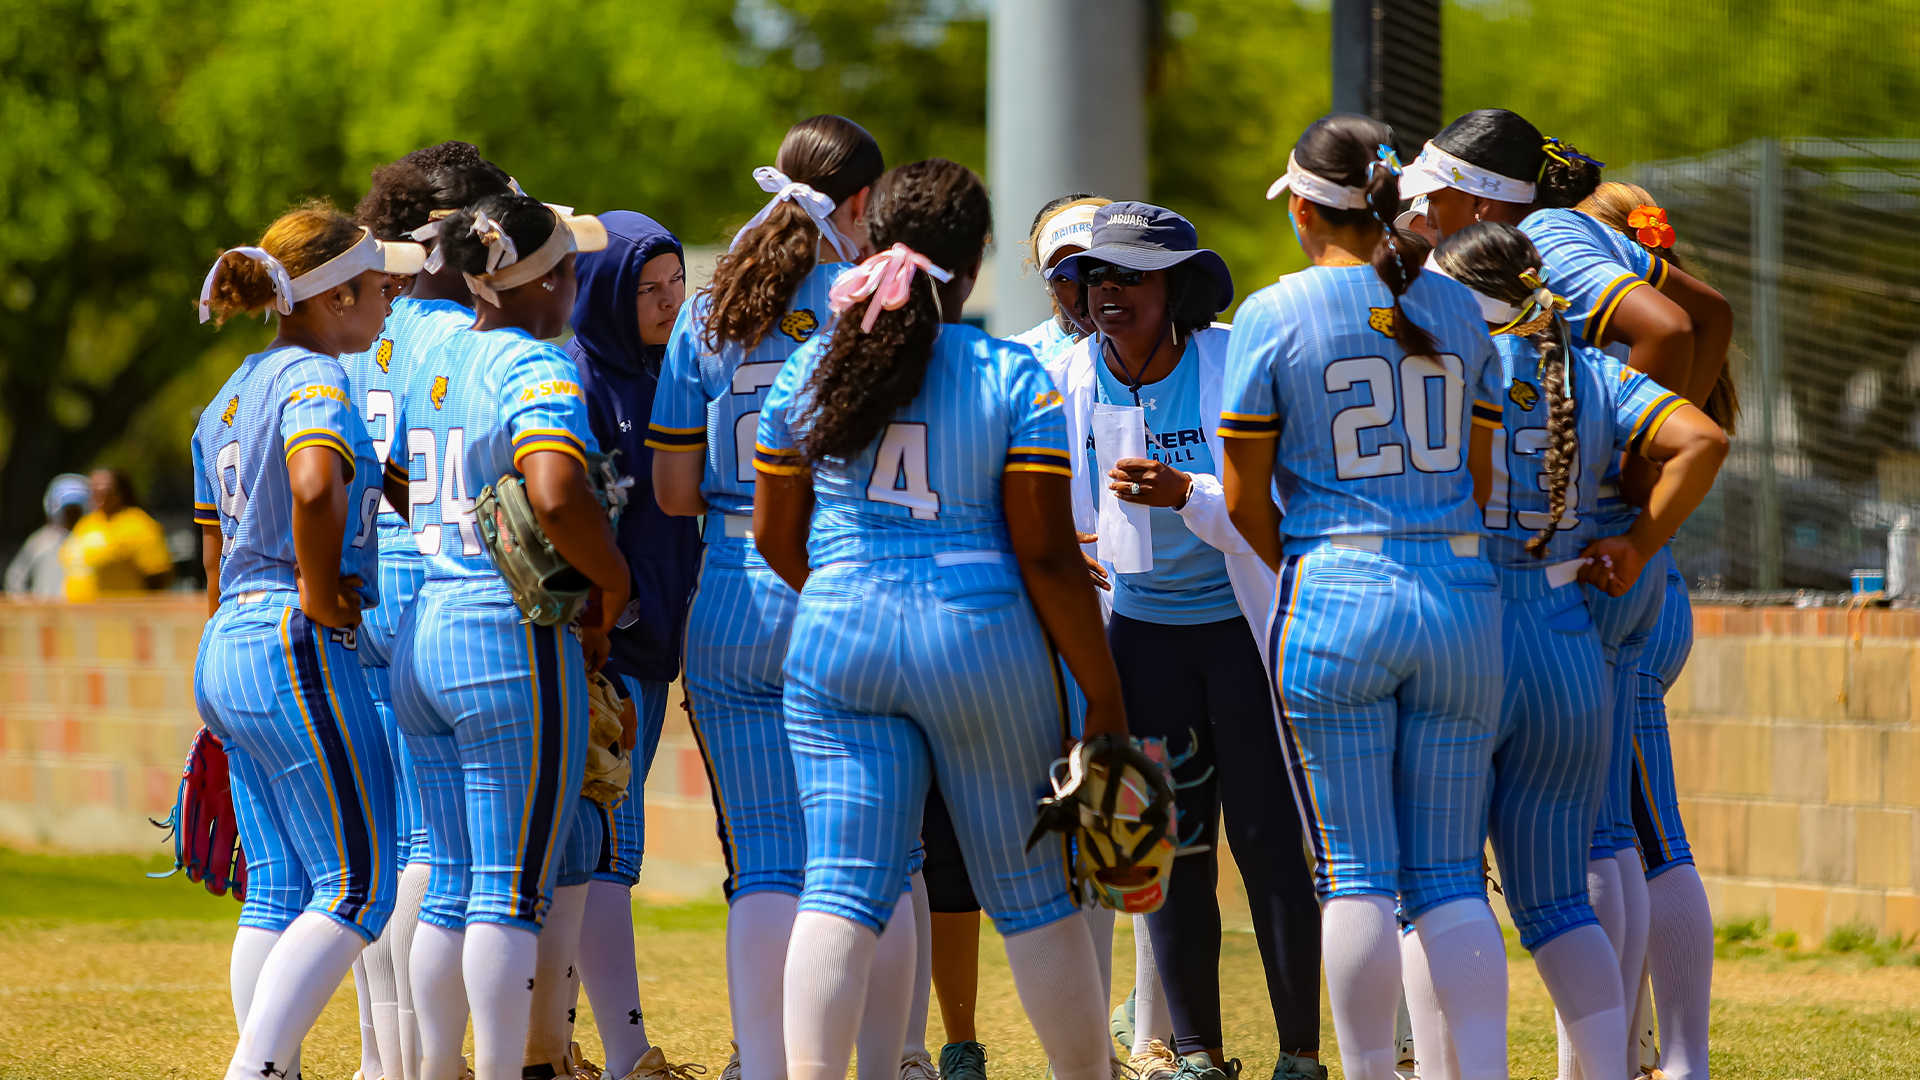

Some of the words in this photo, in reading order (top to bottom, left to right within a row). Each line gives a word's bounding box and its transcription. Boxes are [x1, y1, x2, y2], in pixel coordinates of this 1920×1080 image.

[1049, 222, 1092, 246] JAGUARS
[1106, 213, 1149, 227] JAGUARS
[1324, 352, 1466, 482] 20
[408, 427, 483, 557] 24
[866, 421, 941, 521] 4
[350, 486, 383, 549] 9
